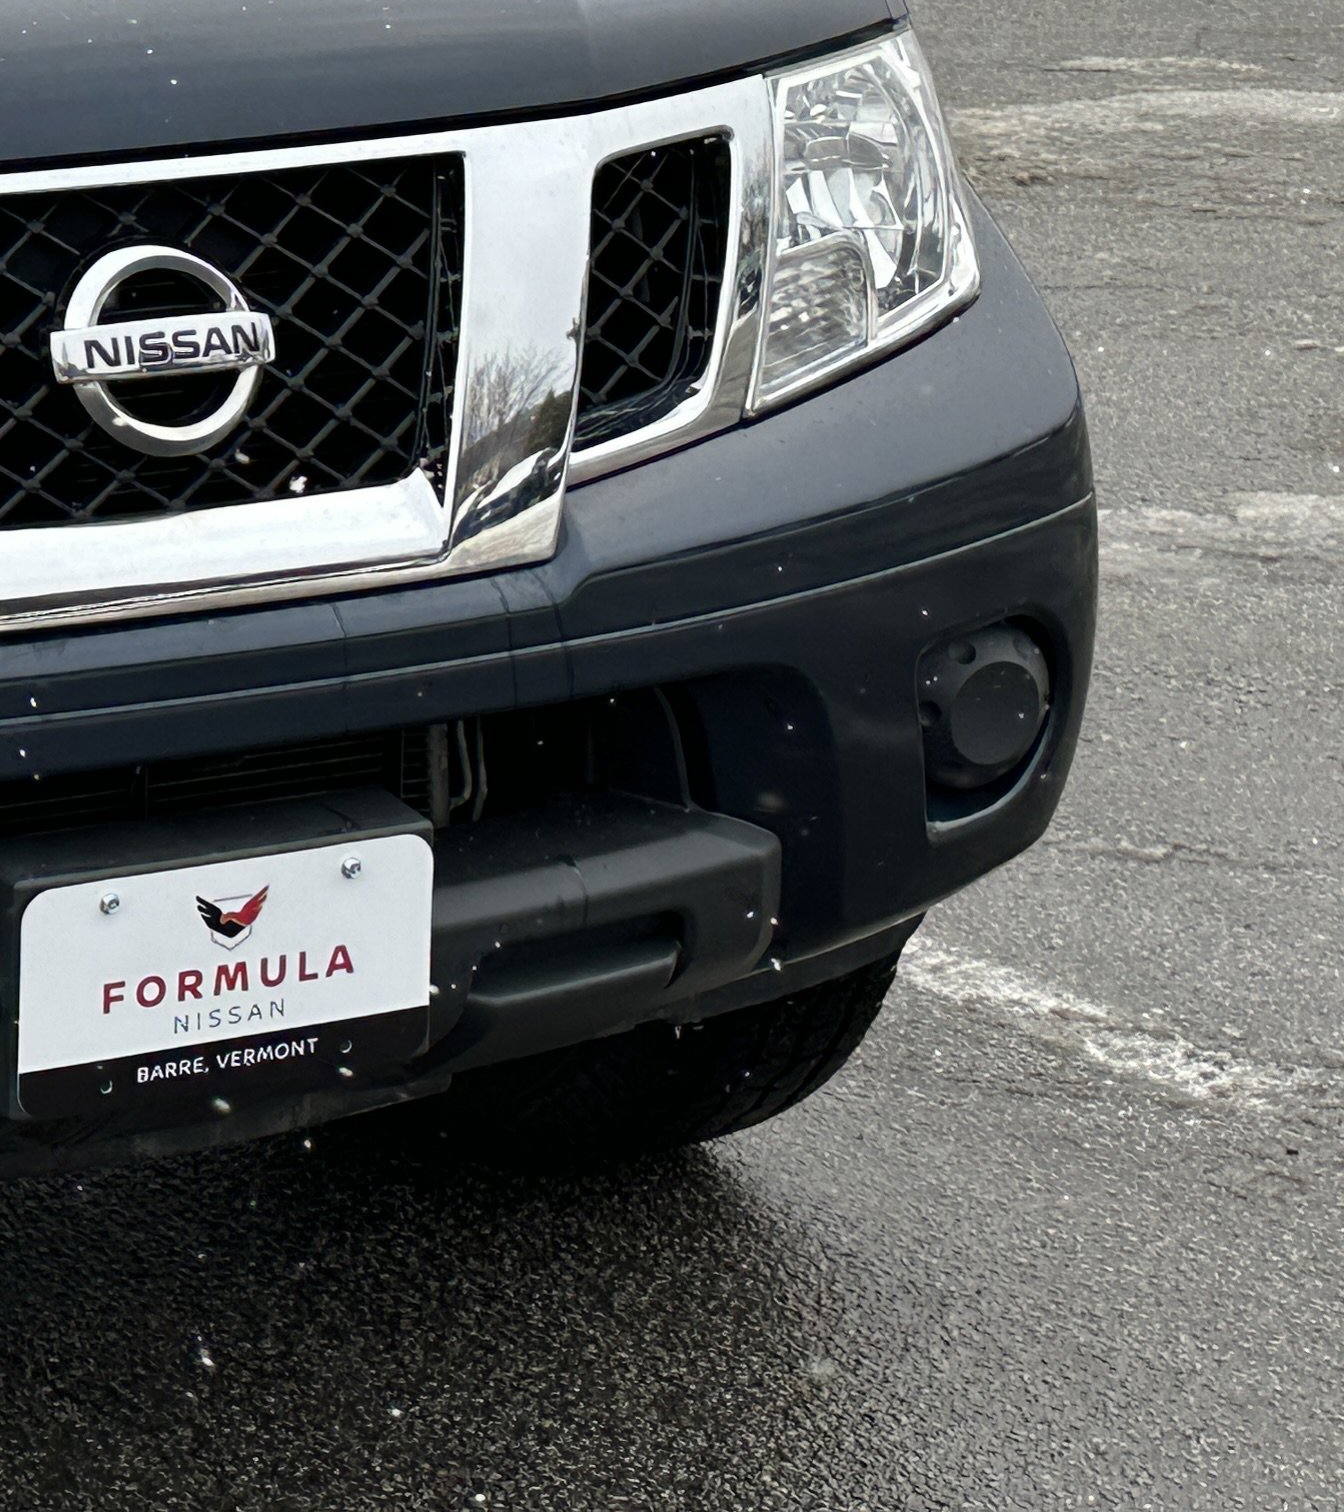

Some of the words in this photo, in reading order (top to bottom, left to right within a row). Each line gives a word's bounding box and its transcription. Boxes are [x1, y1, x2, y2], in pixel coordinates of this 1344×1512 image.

[84, 322, 260, 368] NISSAN
[103, 944, 355, 1015] FORMULA
[173, 998, 285, 1034] NISSAN
[136, 1057, 211, 1084] BARRE,
[216, 1037, 319, 1070] VERMONT
